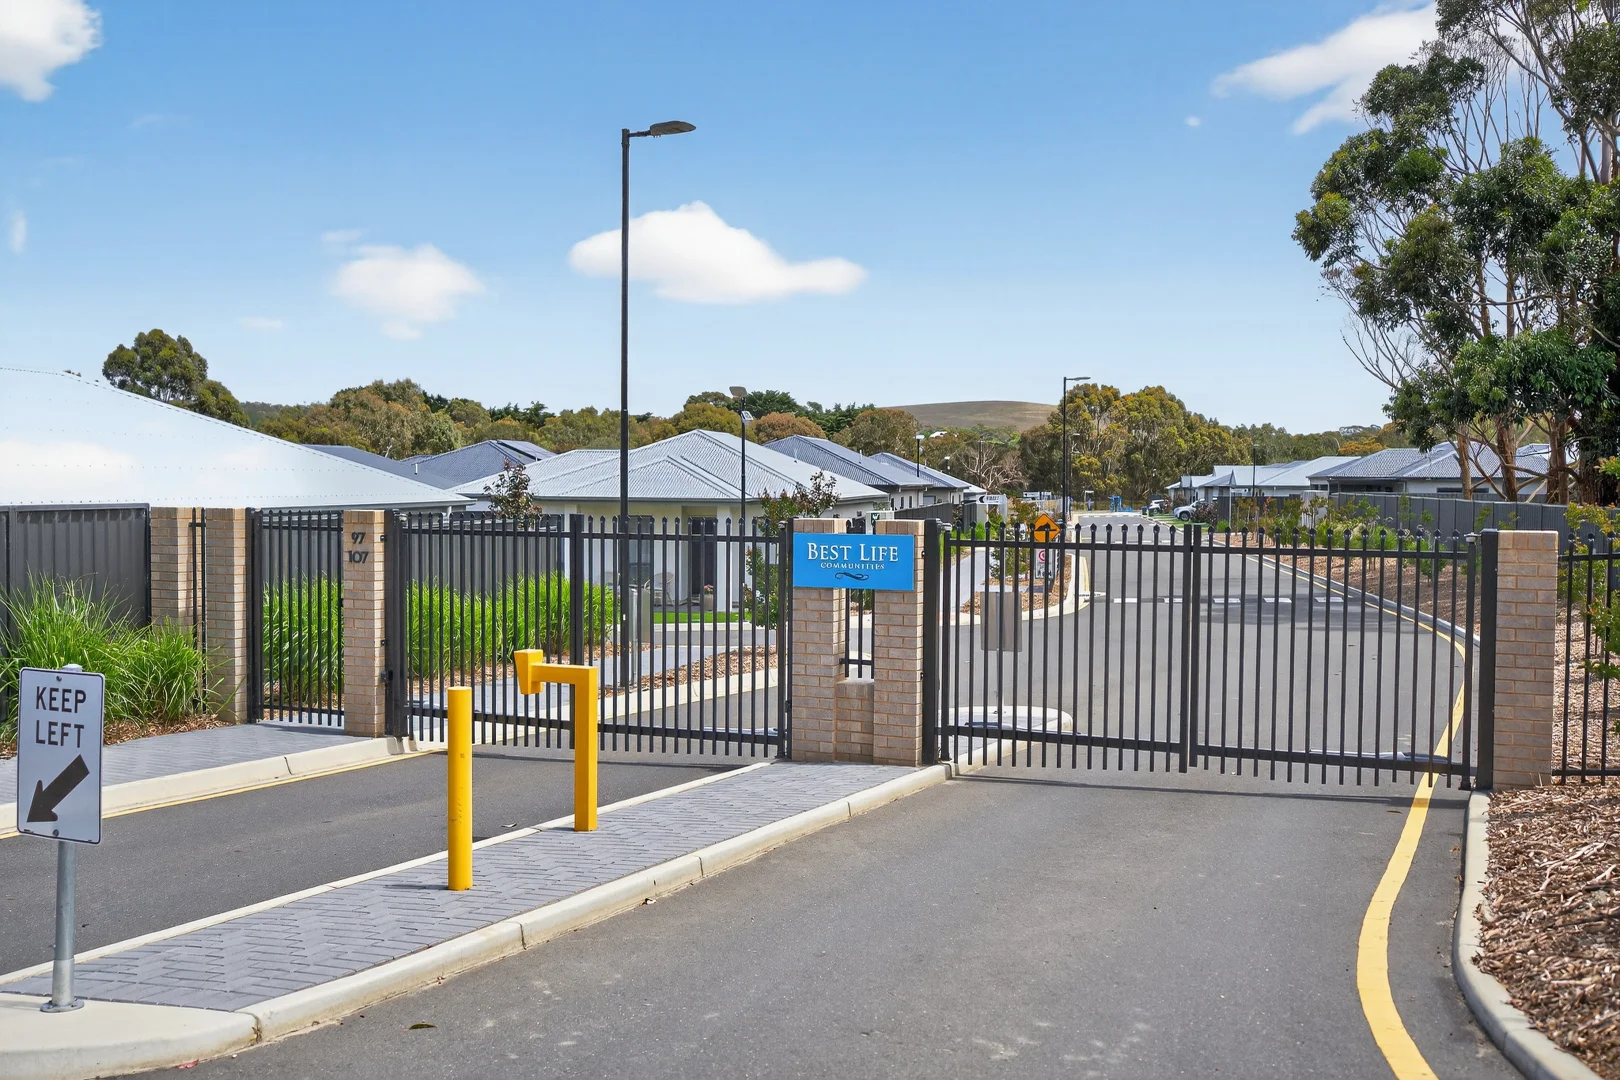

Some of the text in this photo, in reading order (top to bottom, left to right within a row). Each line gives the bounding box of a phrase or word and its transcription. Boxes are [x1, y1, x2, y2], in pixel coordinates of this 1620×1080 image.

[351, 531, 367, 544] 97
[348, 550, 369, 564] 107
[807, 542, 899, 562] BEST LIFE
[820, 562, 885, 570] COMMUNITIES
[35, 685, 87, 714] KEEP
[35, 719, 85, 748] LEFT
